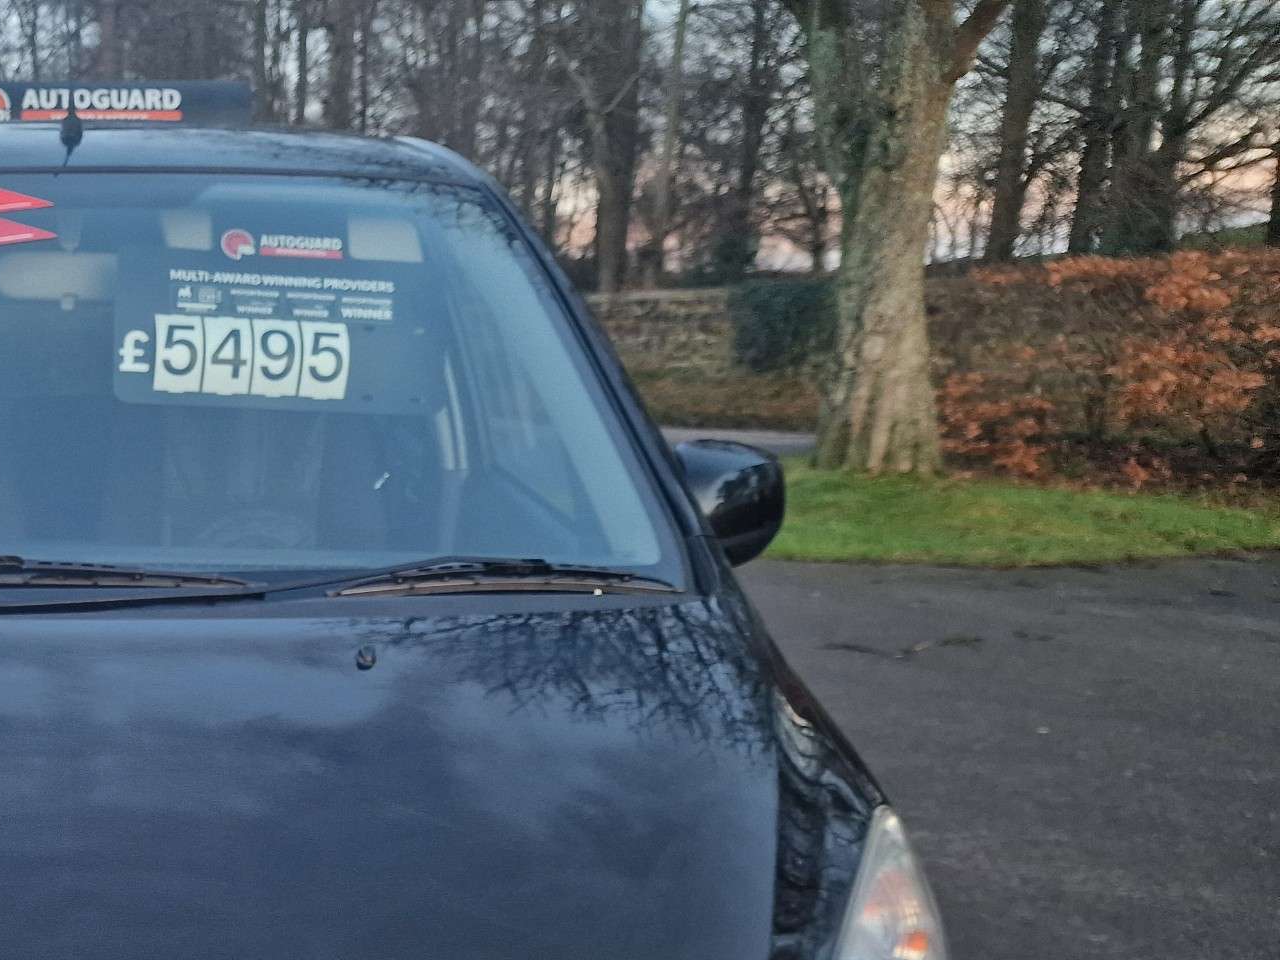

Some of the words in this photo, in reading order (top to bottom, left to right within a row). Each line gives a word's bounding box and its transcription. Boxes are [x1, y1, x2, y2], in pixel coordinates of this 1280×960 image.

[21, 88, 182, 110] AUTOGUARD
[260, 234, 342, 250] AUTOGUARD
[324, 278, 395, 293] PROVIDERS
[341, 308, 393, 320] WINNER
[119, 325, 343, 383] £5495
